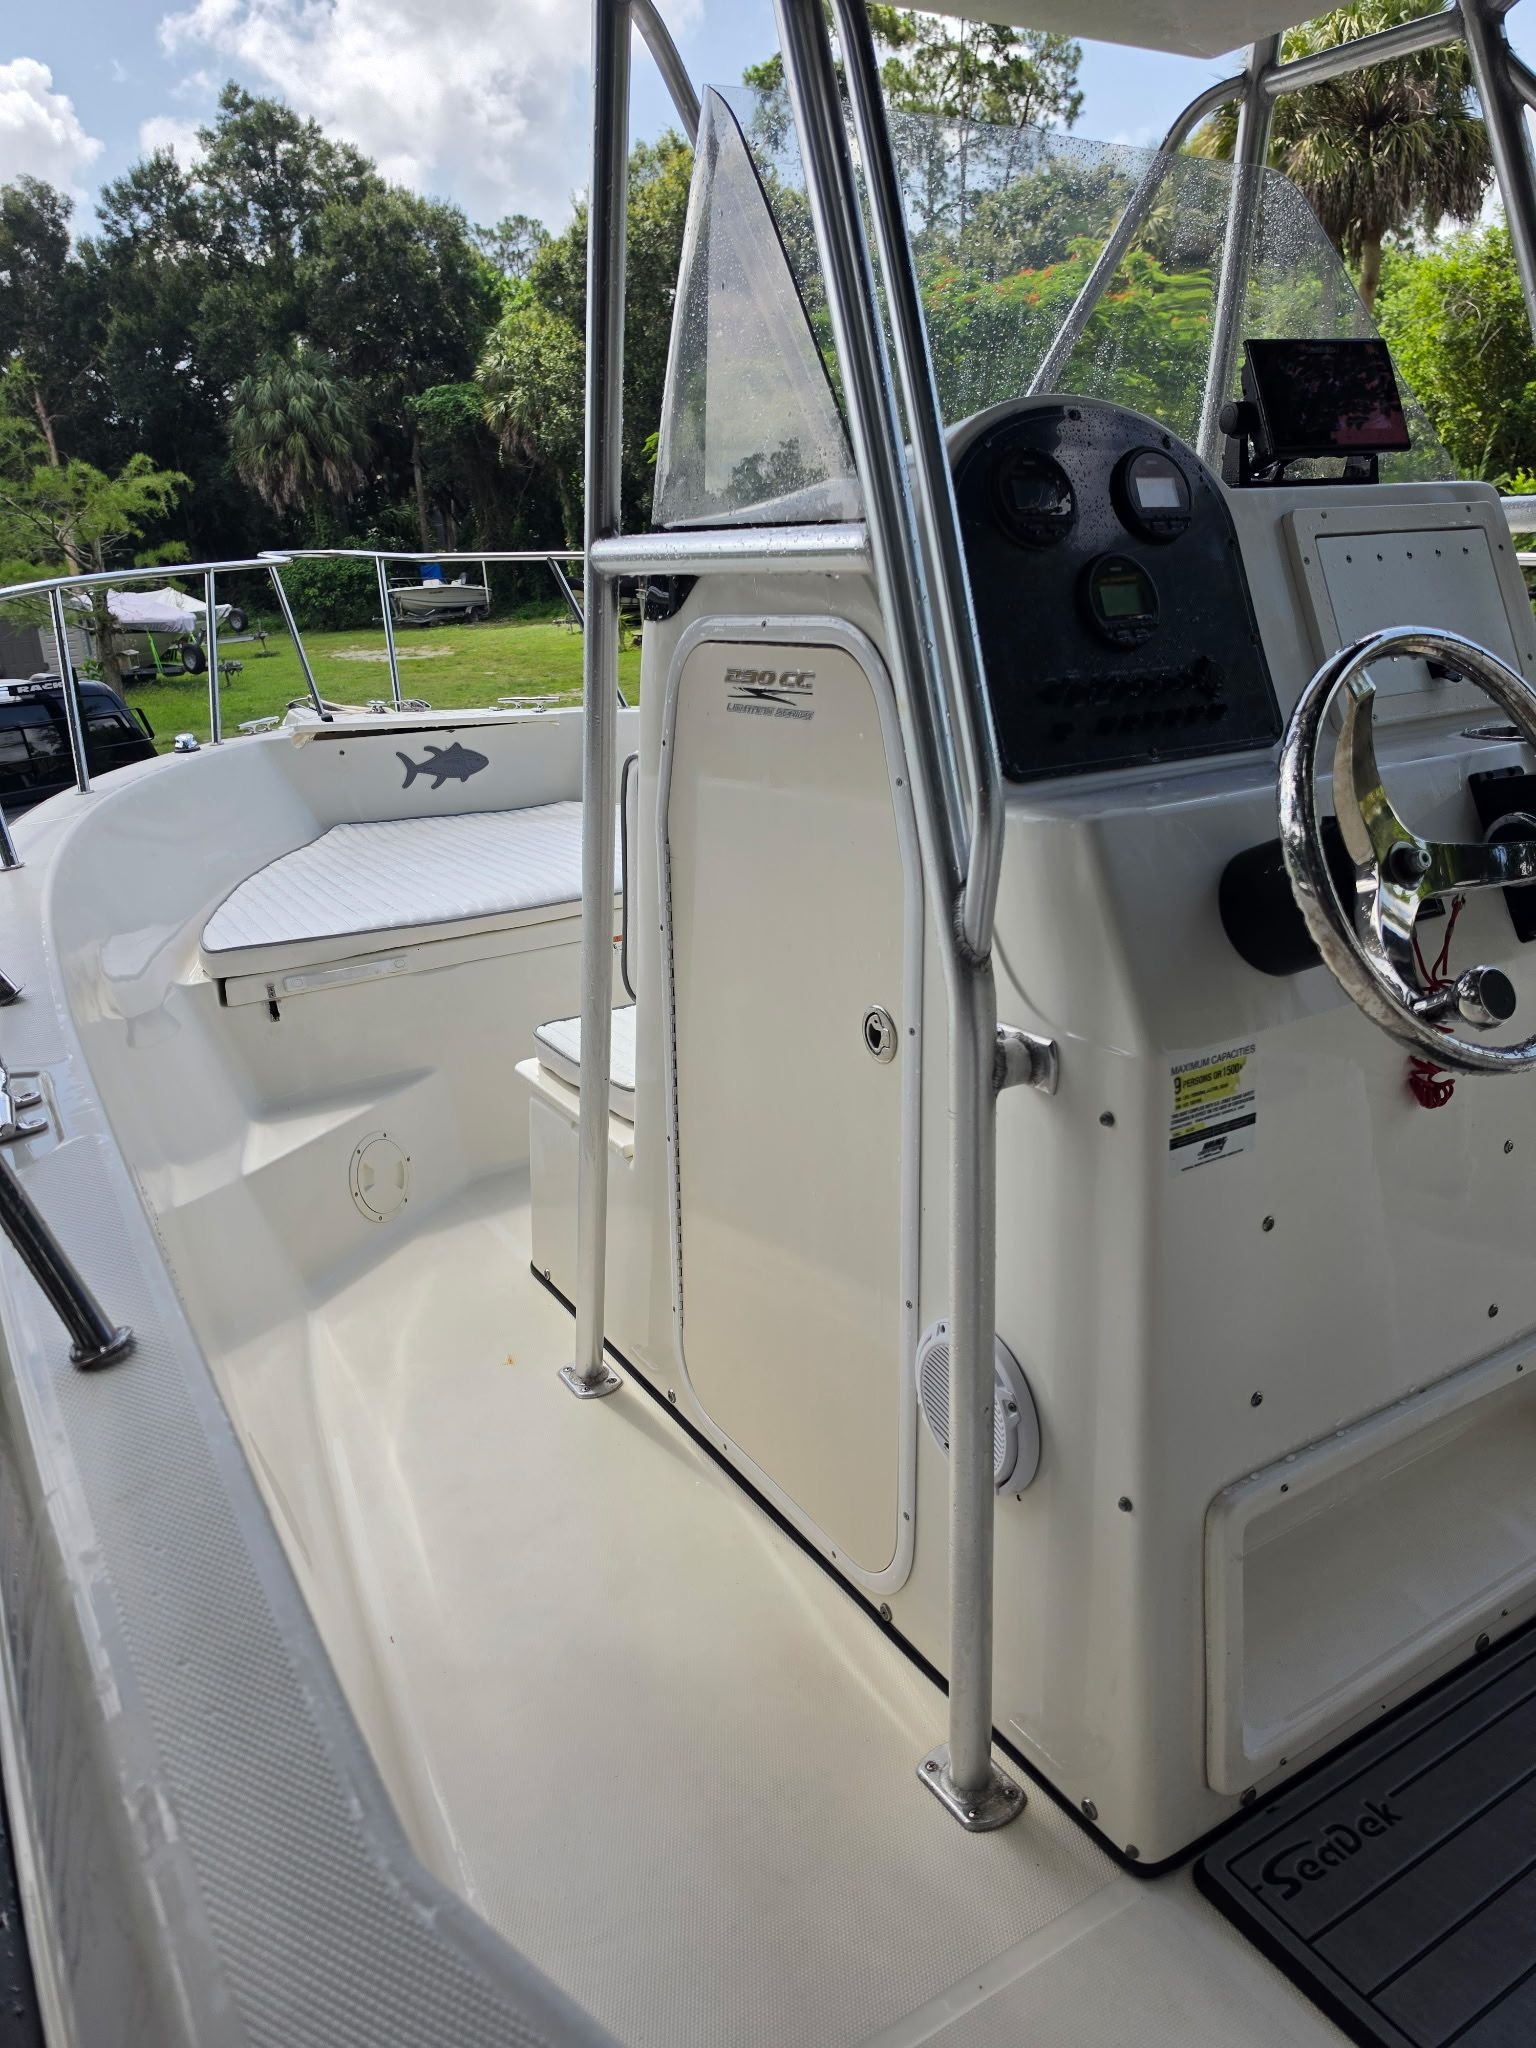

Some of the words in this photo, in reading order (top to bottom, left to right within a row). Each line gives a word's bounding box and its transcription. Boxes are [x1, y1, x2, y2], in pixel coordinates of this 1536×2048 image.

[779, 671, 816, 689] CC
[1171, 1057, 1209, 1076] MAXIMUM
[1211, 1044, 1256, 1065] CAPACITIES
[1174, 1077, 1182, 1095] 9
[1182, 1073, 1212, 1089] PERSONS
[1262, 1801, 1403, 1900] SeaDek
